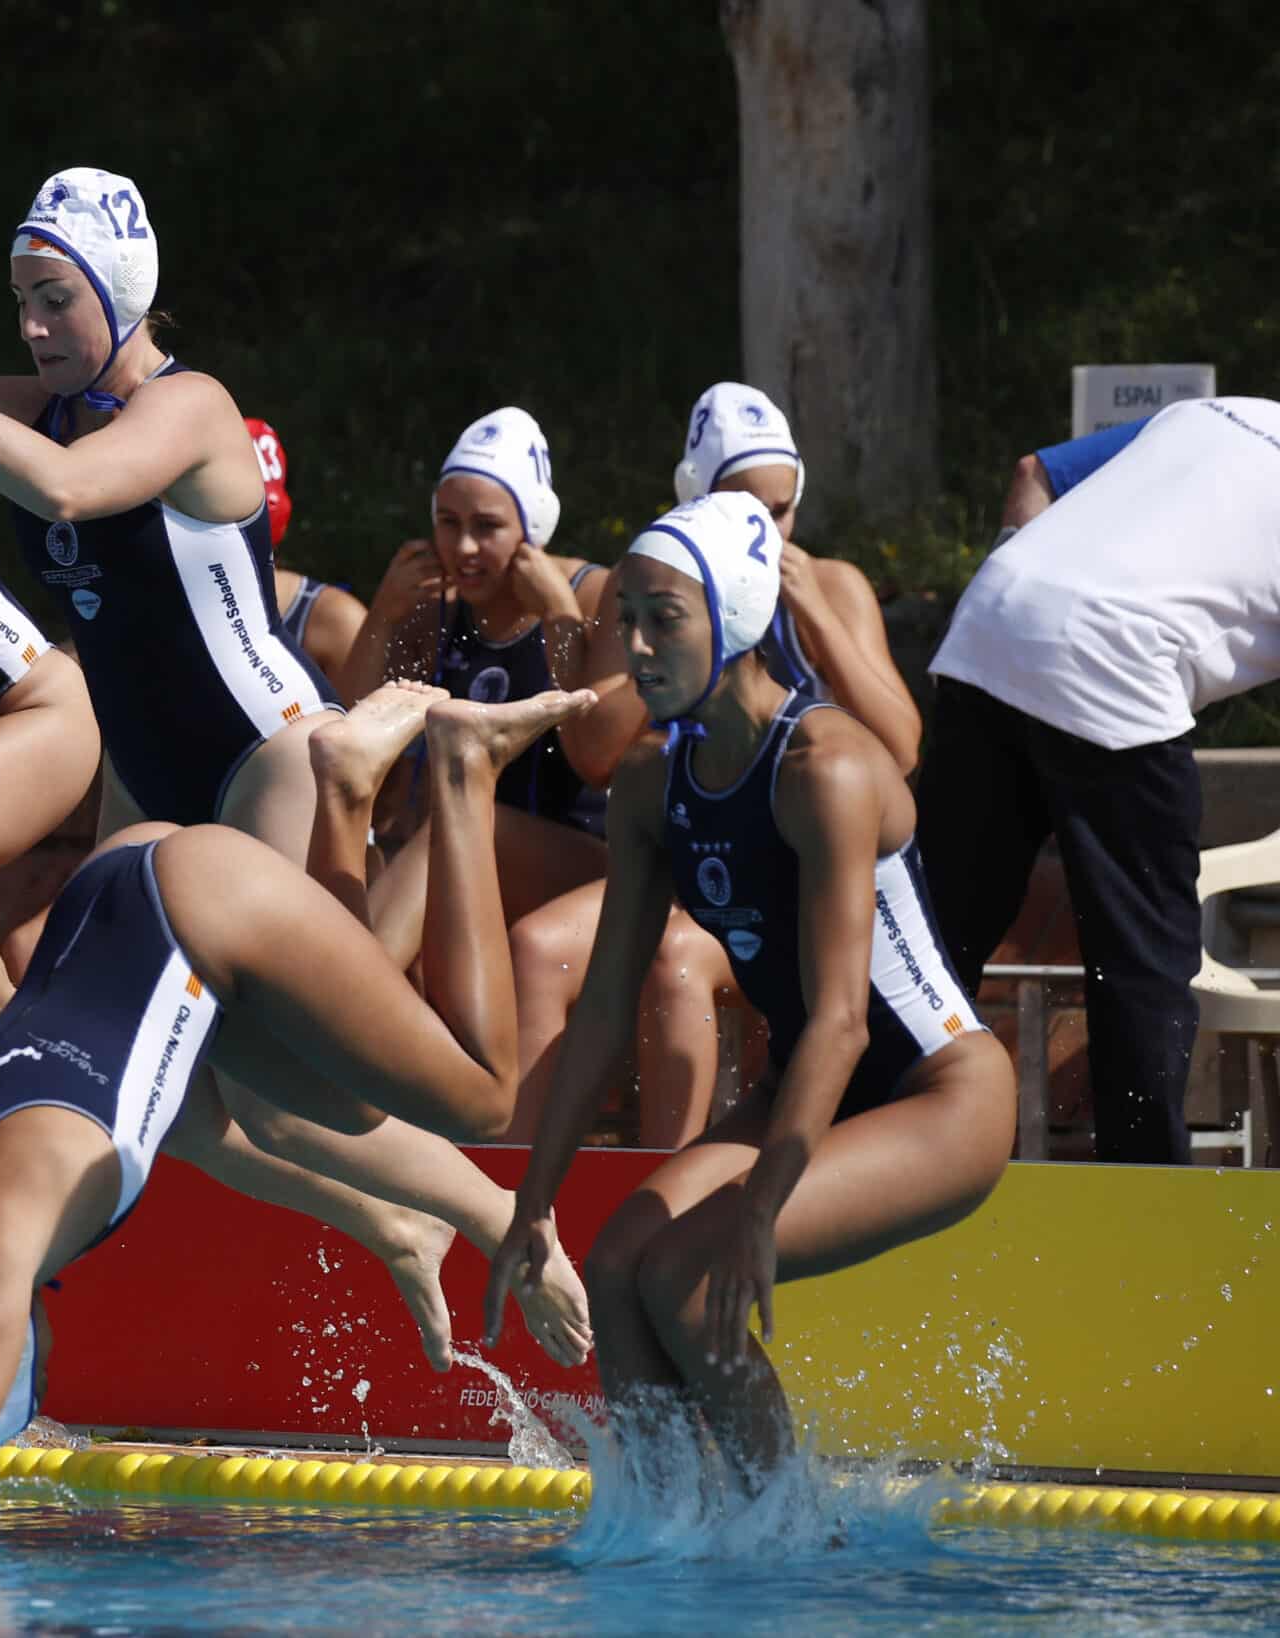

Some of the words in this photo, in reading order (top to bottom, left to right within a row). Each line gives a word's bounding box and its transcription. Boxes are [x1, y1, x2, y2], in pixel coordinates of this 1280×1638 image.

[99, 190, 148, 239] 12
[1114, 385, 1162, 407] ESPAI
[690, 408, 710, 449] 3
[747, 514, 769, 566] 2
[207, 563, 240, 619] Sabadell
[231, 618, 263, 669] Natació
[260, 665, 284, 694] Club
[894, 938, 926, 986] Natació
[922, 981, 943, 1011] Club
[172, 1005, 191, 1035] Club
